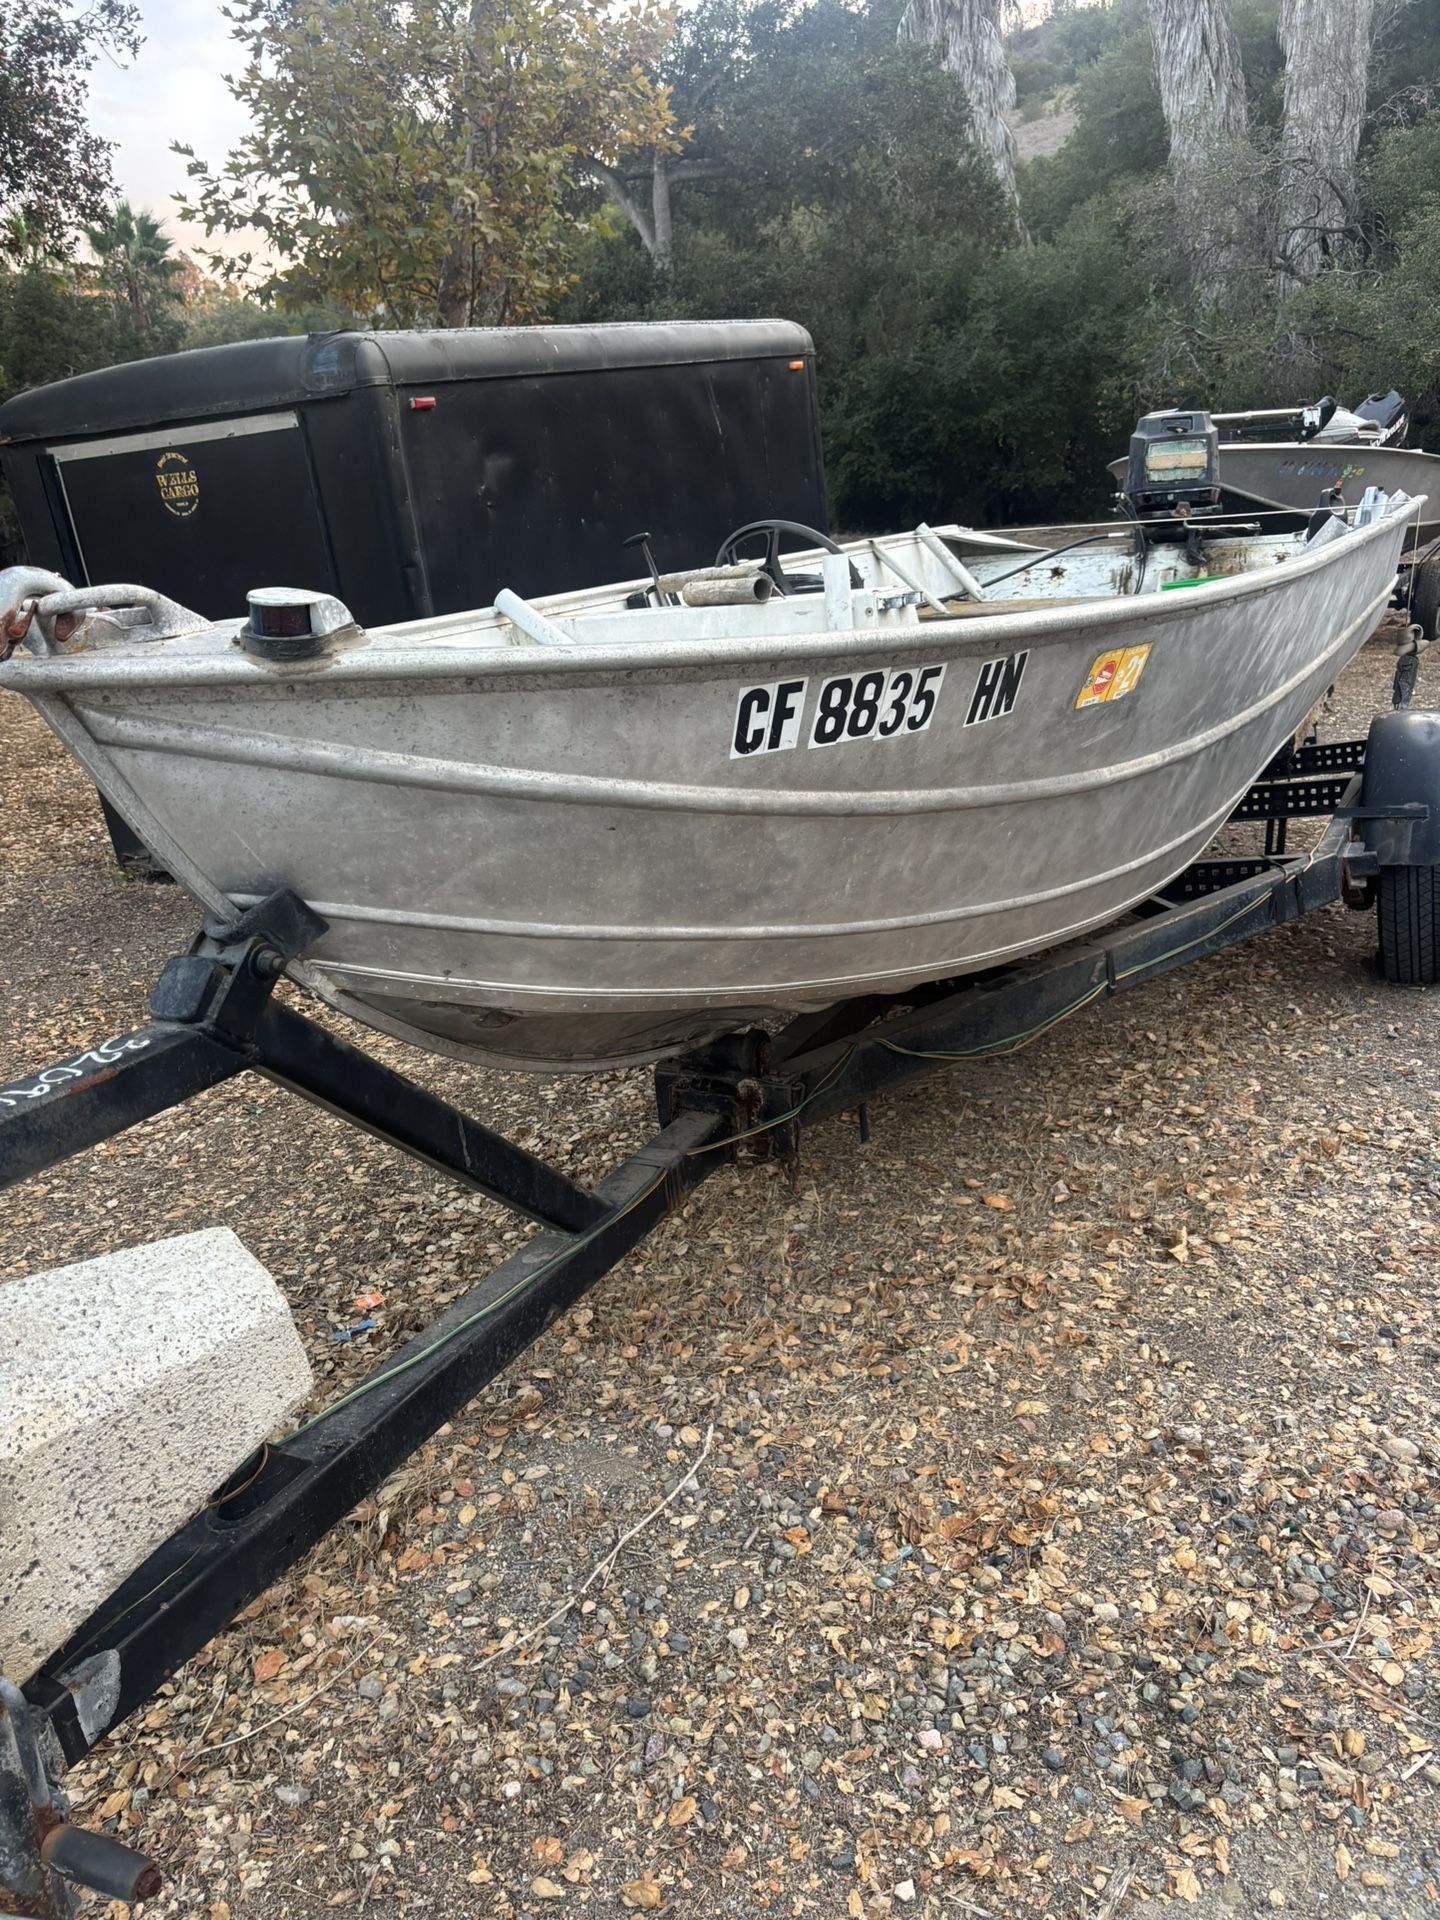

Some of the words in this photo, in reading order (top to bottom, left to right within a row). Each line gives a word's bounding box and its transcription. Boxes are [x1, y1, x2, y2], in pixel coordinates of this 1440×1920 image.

[156, 470, 197, 487] WELLS
[161, 484, 199, 499] CARGO
[734, 681, 804, 755] CF
[814, 667, 943, 744] 8835
[966, 652, 1029, 725] HN
